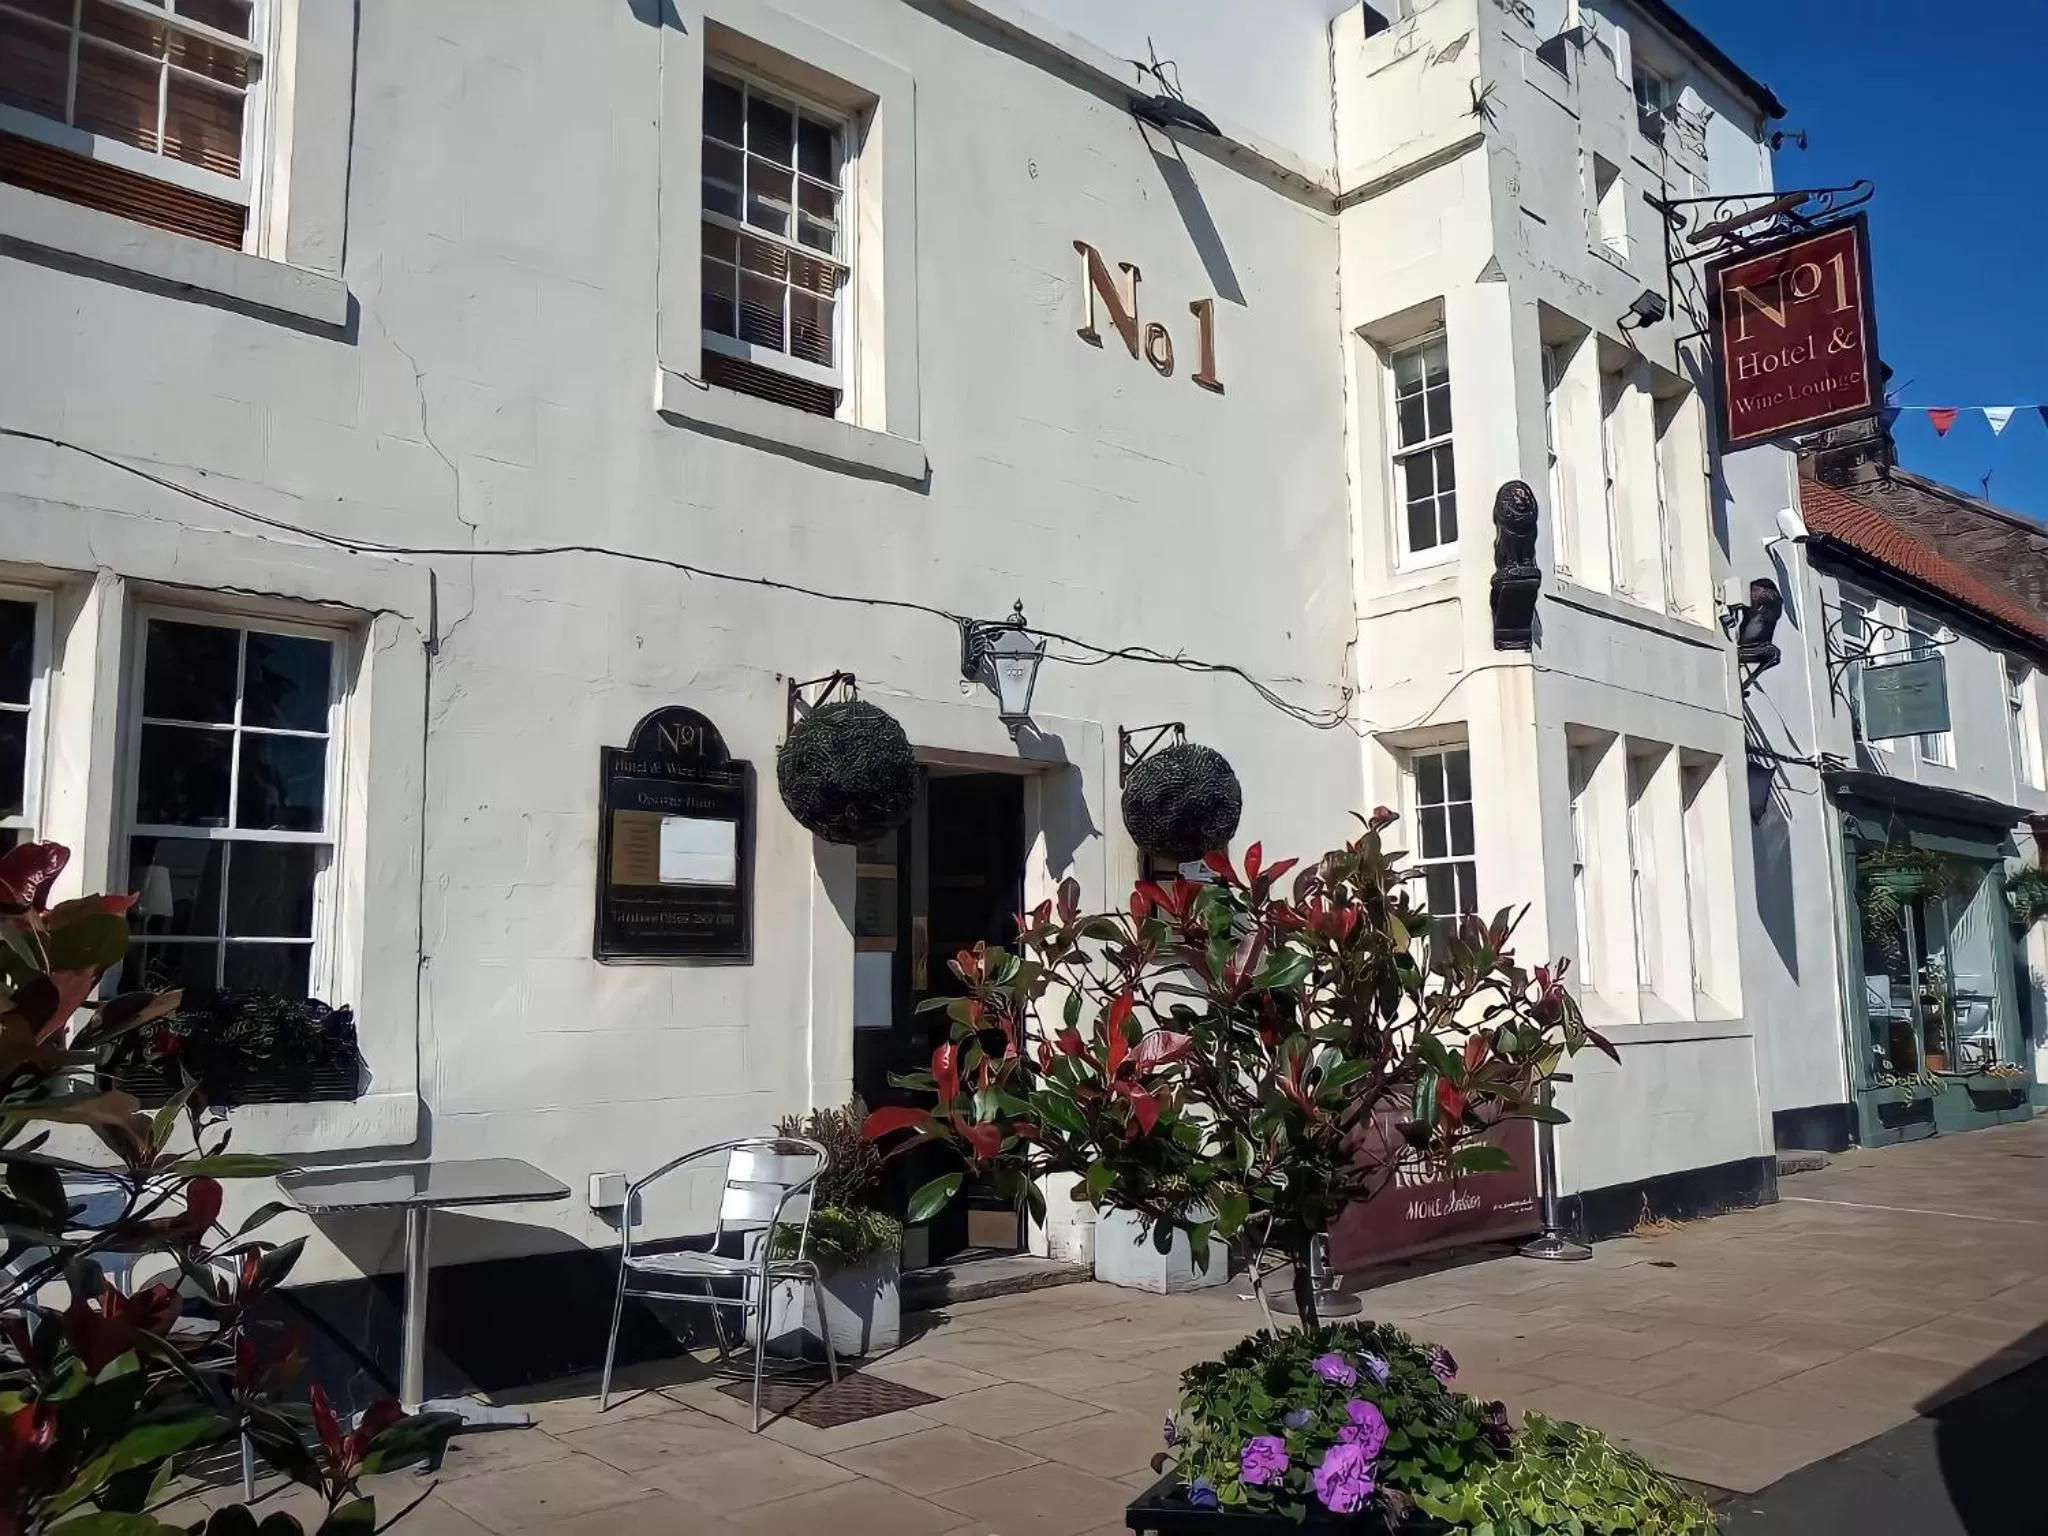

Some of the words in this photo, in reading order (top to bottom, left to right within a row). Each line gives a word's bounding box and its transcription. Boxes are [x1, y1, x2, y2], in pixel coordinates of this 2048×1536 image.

[1738, 333, 1817, 380] Hotel
[1828, 327, 1857, 354] &
[1736, 391, 1784, 414] Wine
[1789, 371, 1861, 400] Lounge
